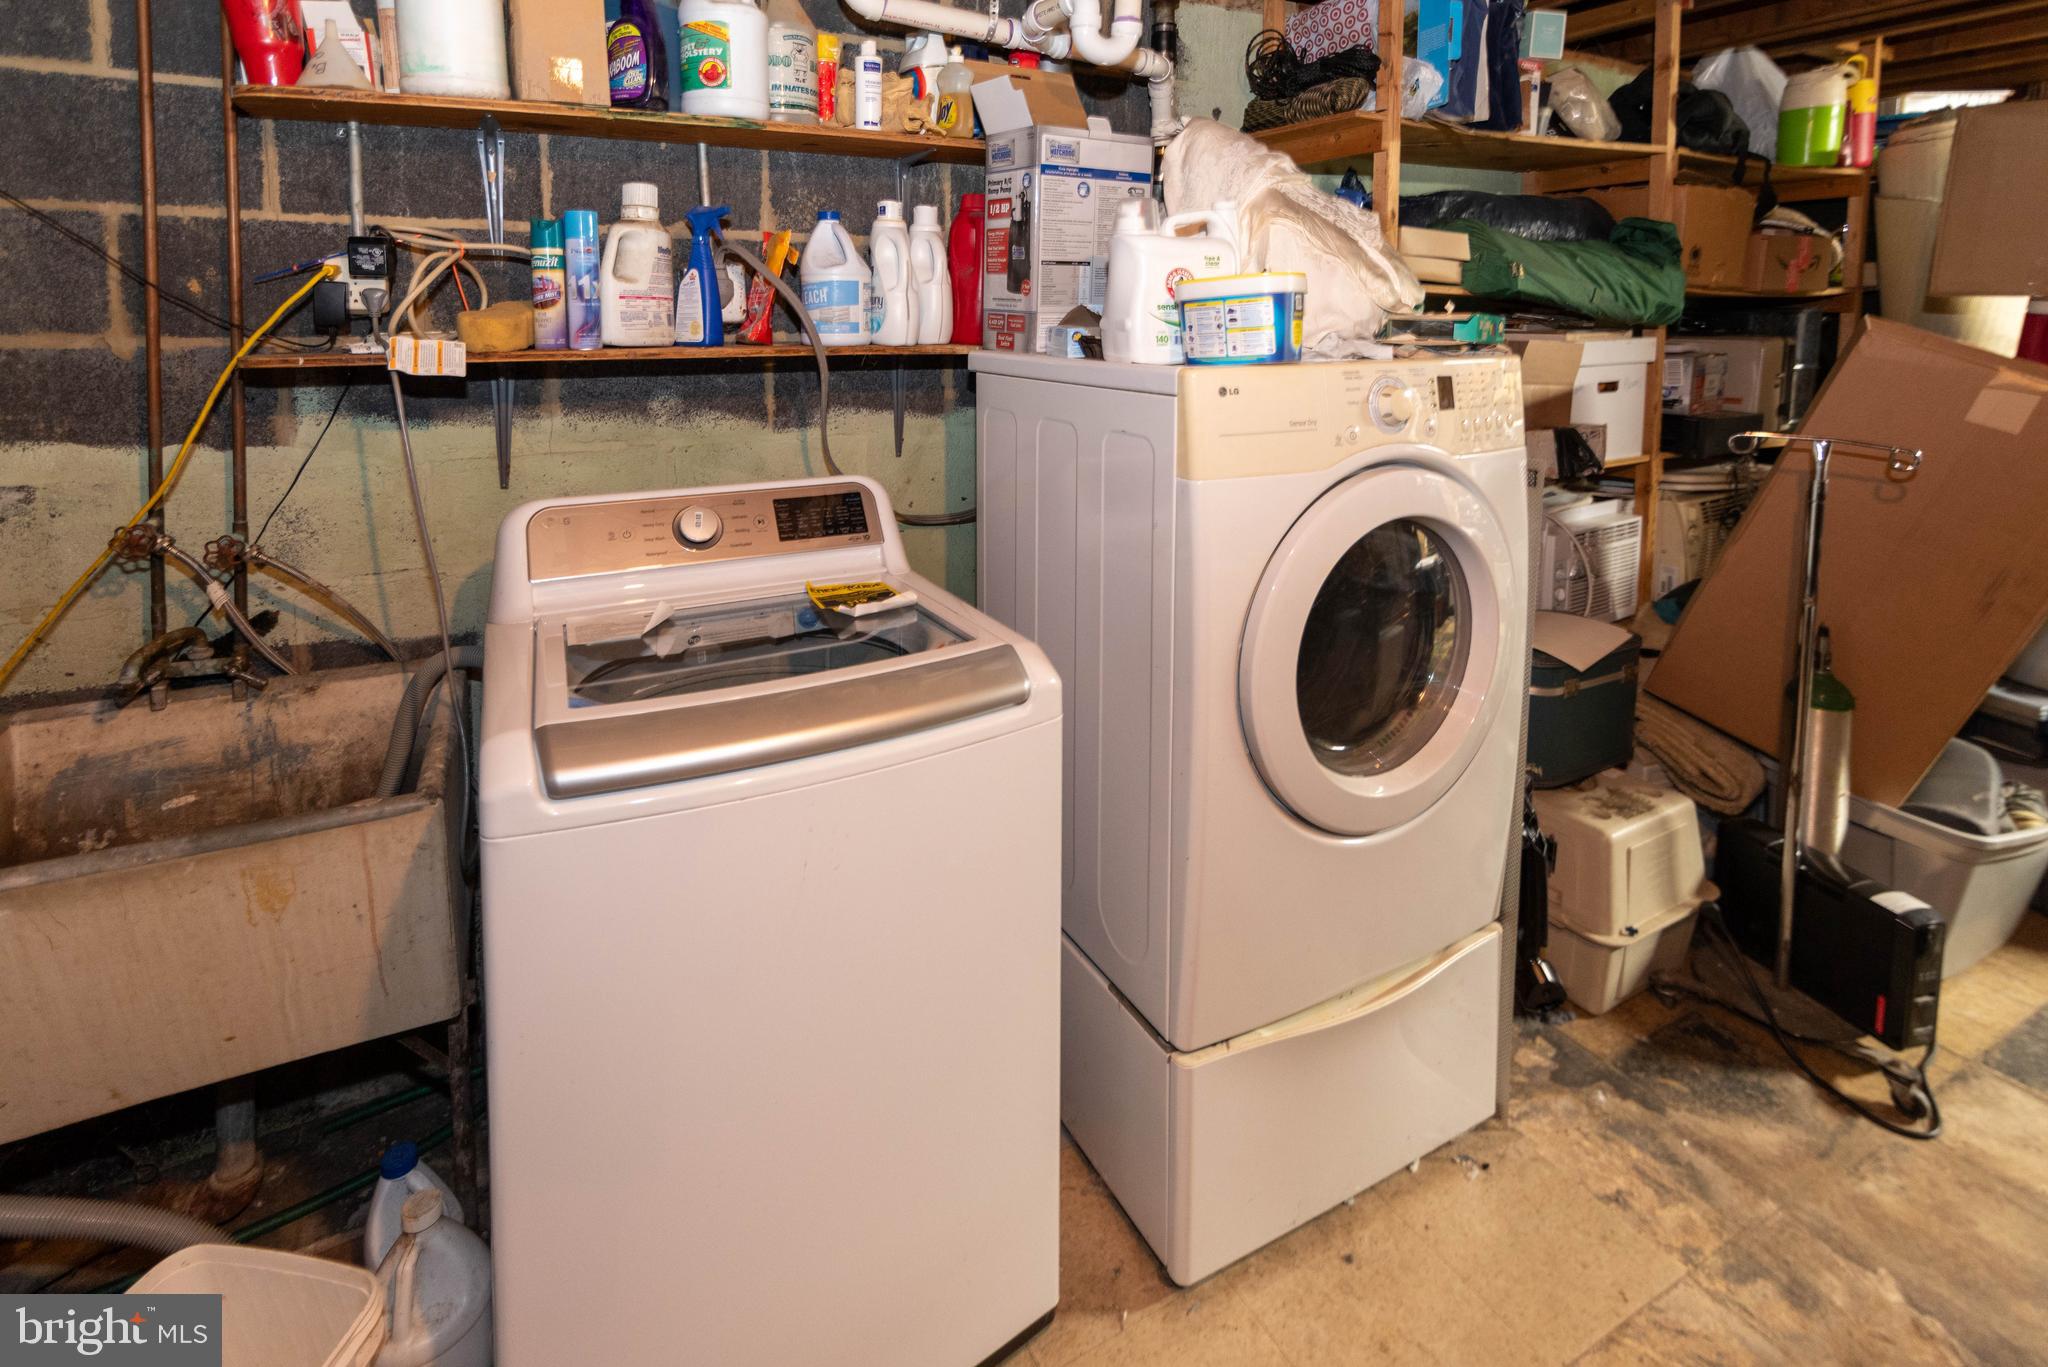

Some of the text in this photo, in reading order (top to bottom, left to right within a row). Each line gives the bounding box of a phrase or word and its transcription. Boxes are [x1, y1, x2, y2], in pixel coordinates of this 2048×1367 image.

[609, 51, 640, 77] KABOOM
[989, 202, 1010, 216] 1/2 HP
[1155, 335, 1169, 343] 140
[1229, 387, 1240, 396] LG
